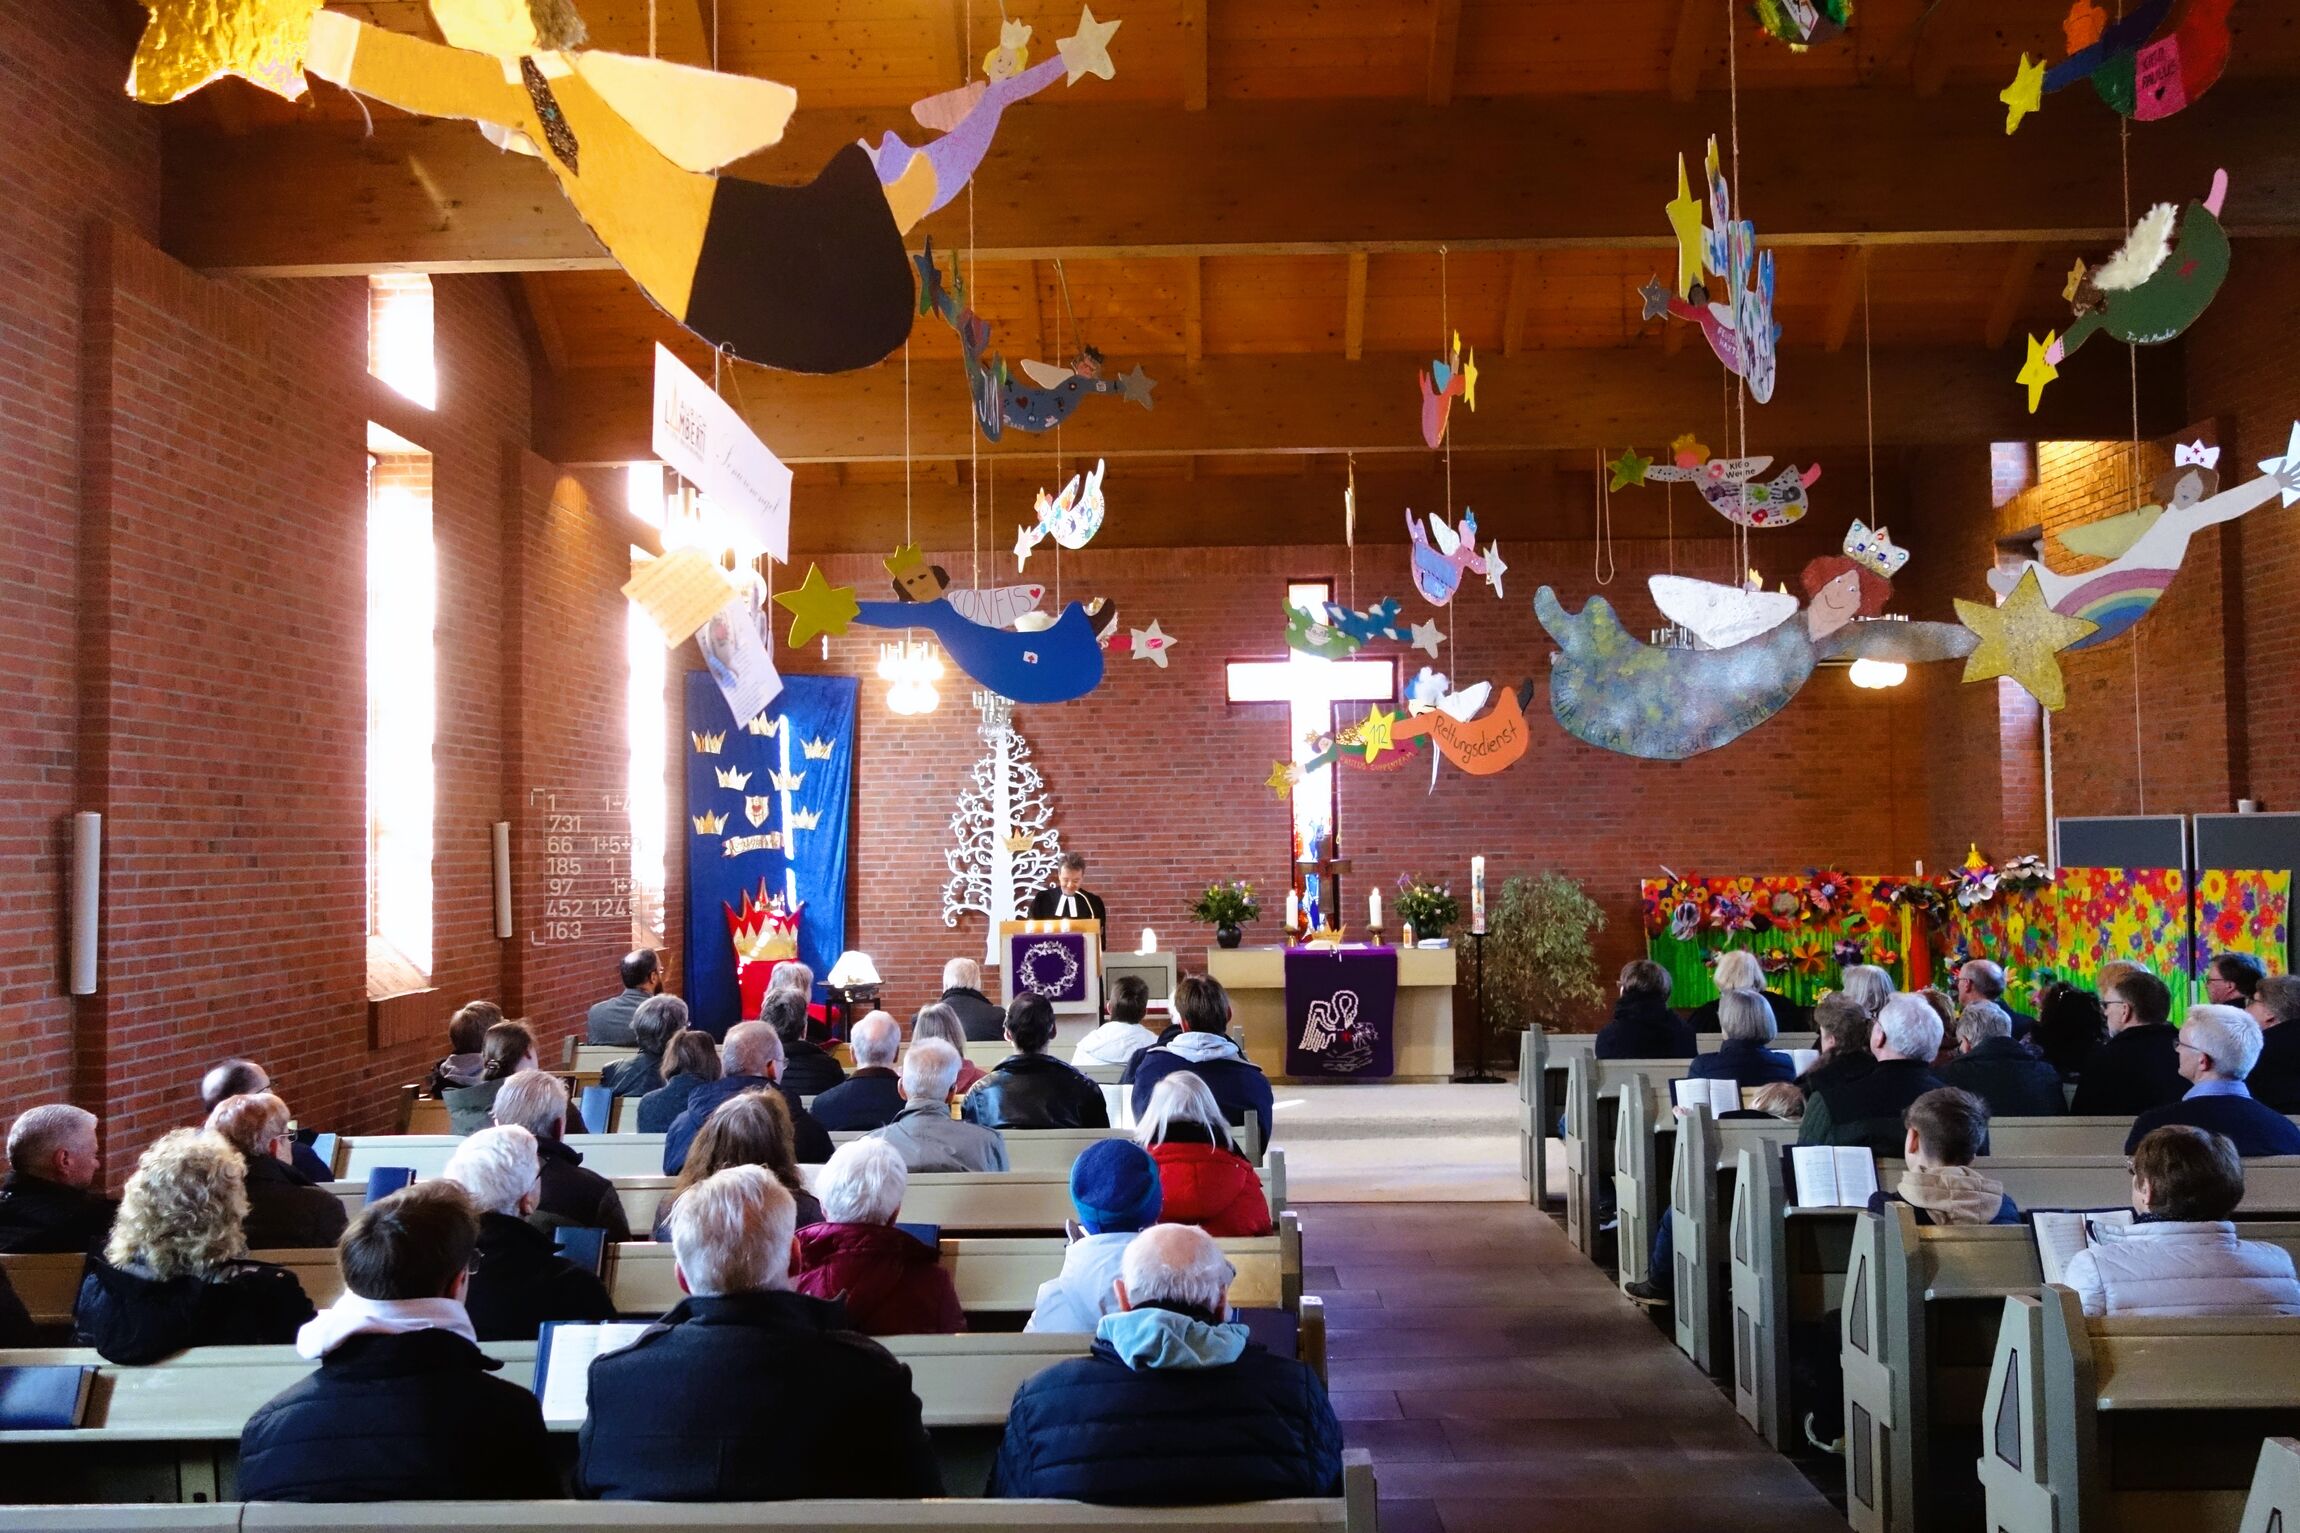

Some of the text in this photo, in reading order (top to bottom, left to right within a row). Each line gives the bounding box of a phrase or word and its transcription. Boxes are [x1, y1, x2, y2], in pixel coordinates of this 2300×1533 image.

[953, 587, 1032, 624] KONFIS
[1369, 723, 1388, 744] 112
[1433, 719, 1519, 764] Rettungsdienst
[548, 794, 556, 812] 1
[549, 815, 581, 833] 731
[548, 836, 573, 854] 66
[547, 857, 615, 876] 185 1
[550, 879, 574, 897] 97
[546, 899, 584, 918] 452
[547, 920, 582, 940] 163
